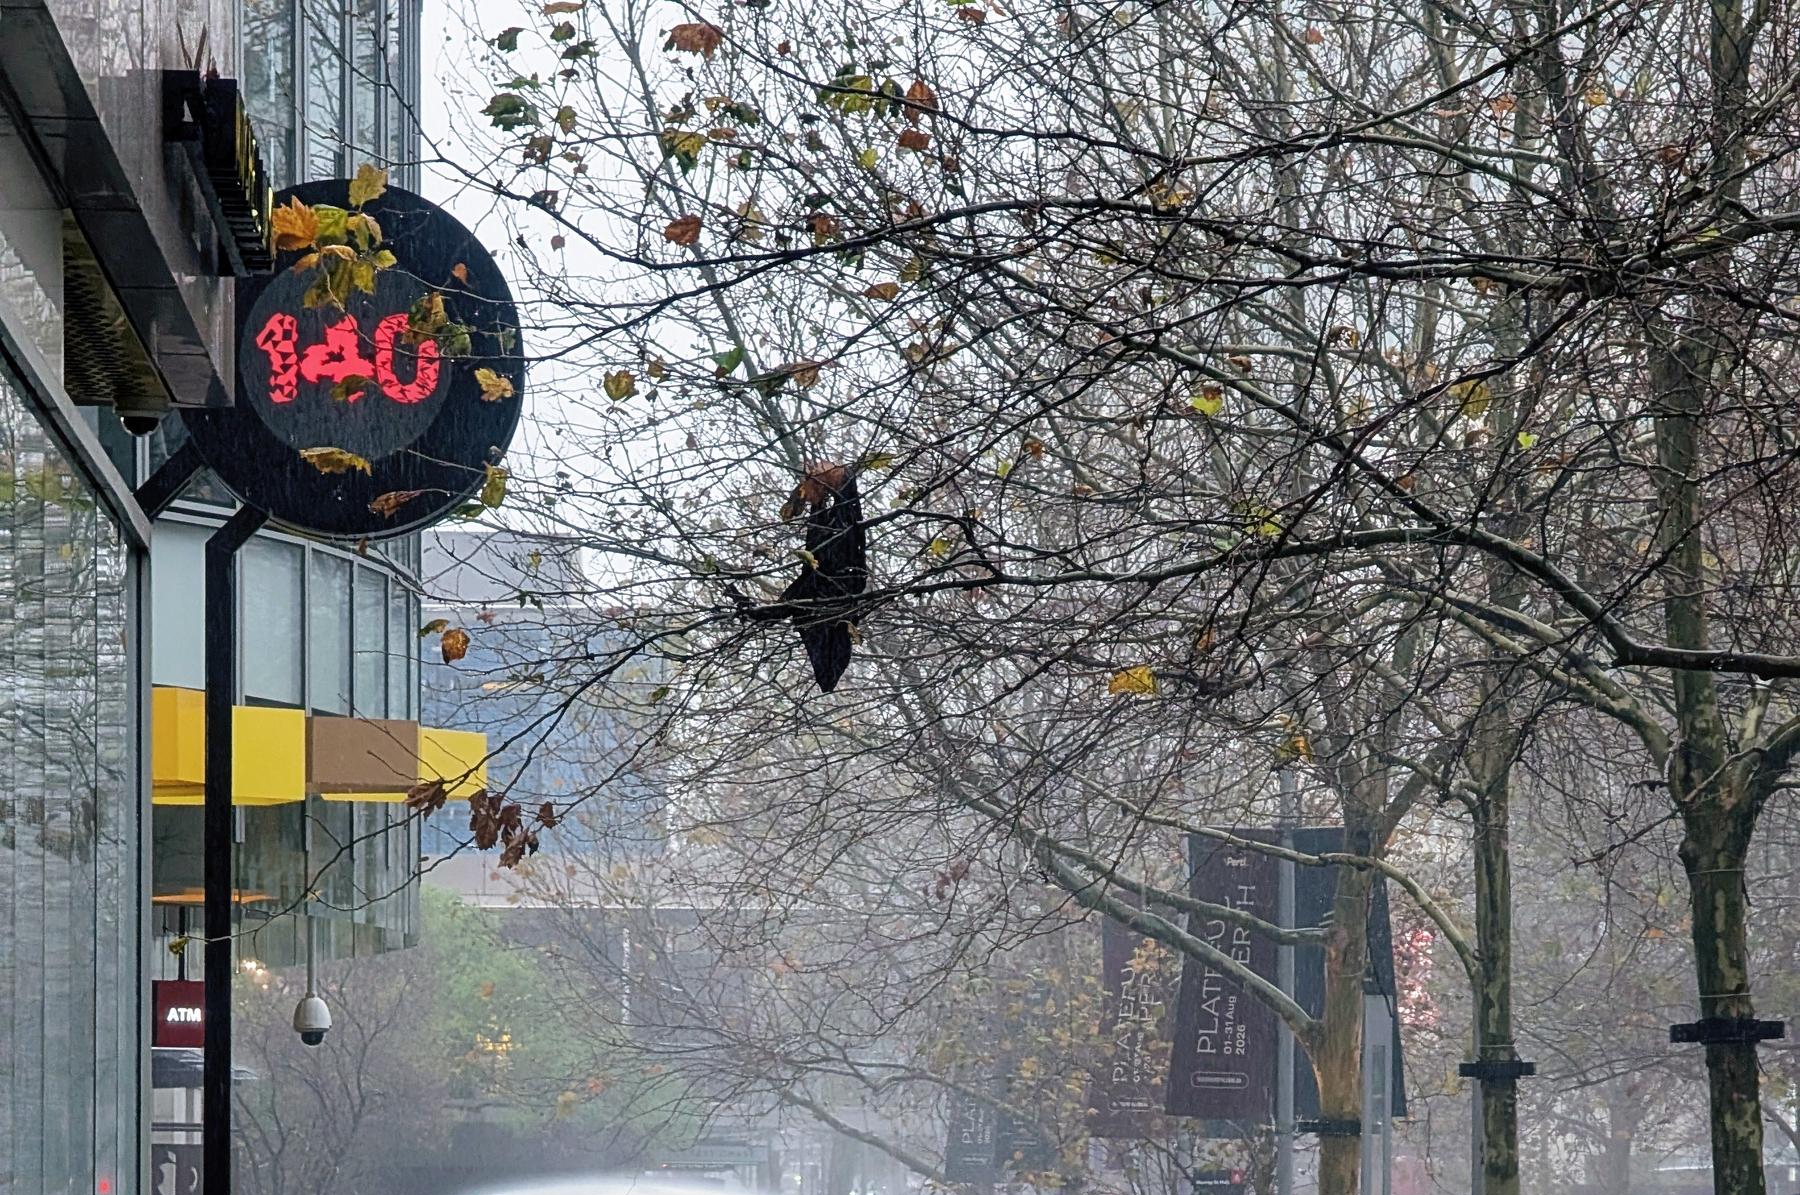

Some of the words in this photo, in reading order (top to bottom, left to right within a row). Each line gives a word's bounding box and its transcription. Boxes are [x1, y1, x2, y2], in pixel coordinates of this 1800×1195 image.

[256, 312, 441, 404] 140
[1196, 896, 1231, 1054] PLATEU
[167, 1007, 202, 1022] ATM
[1235, 1024, 1246, 1055] 2026
